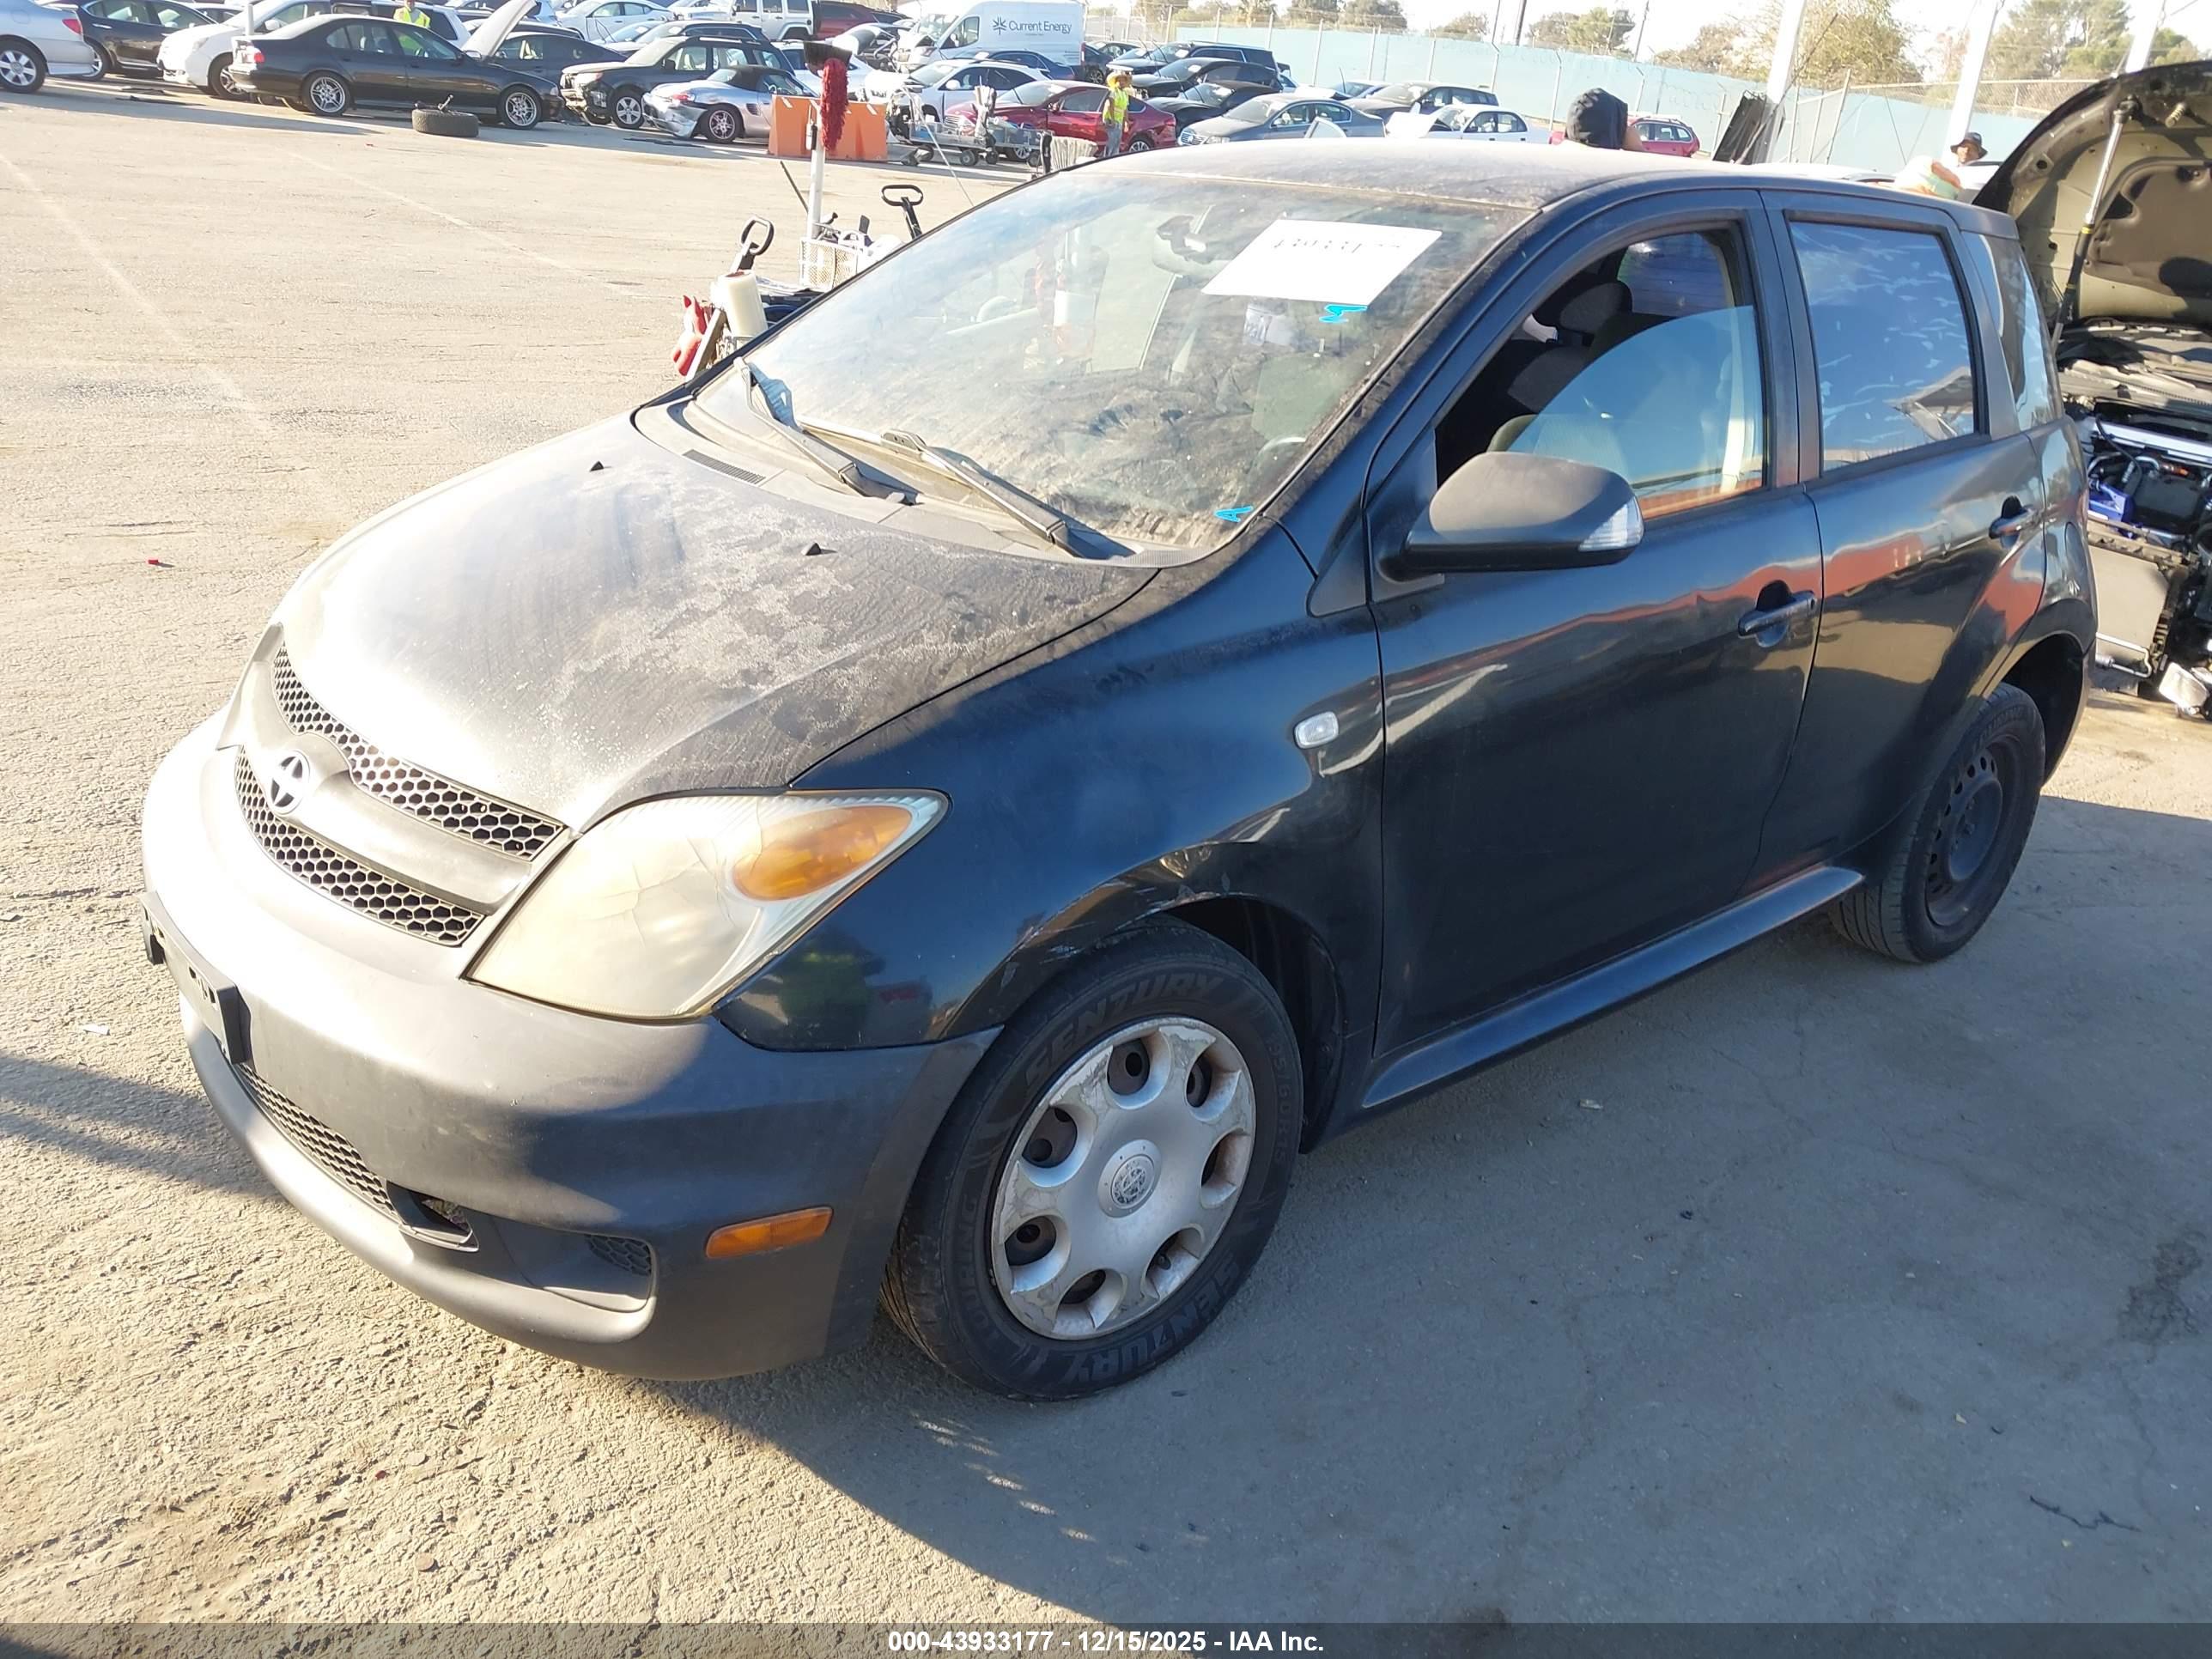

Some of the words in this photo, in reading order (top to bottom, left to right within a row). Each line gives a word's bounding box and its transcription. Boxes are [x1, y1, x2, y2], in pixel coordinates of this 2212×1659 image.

[1008, 20, 1042, 32] Current
[1043, 21, 1072, 34] Energy
[1024, 971, 1226, 1085] SENTURY
[956, 1194, 1000, 1340] TOURING
[1058, 1250, 1241, 1386] SENTURY
